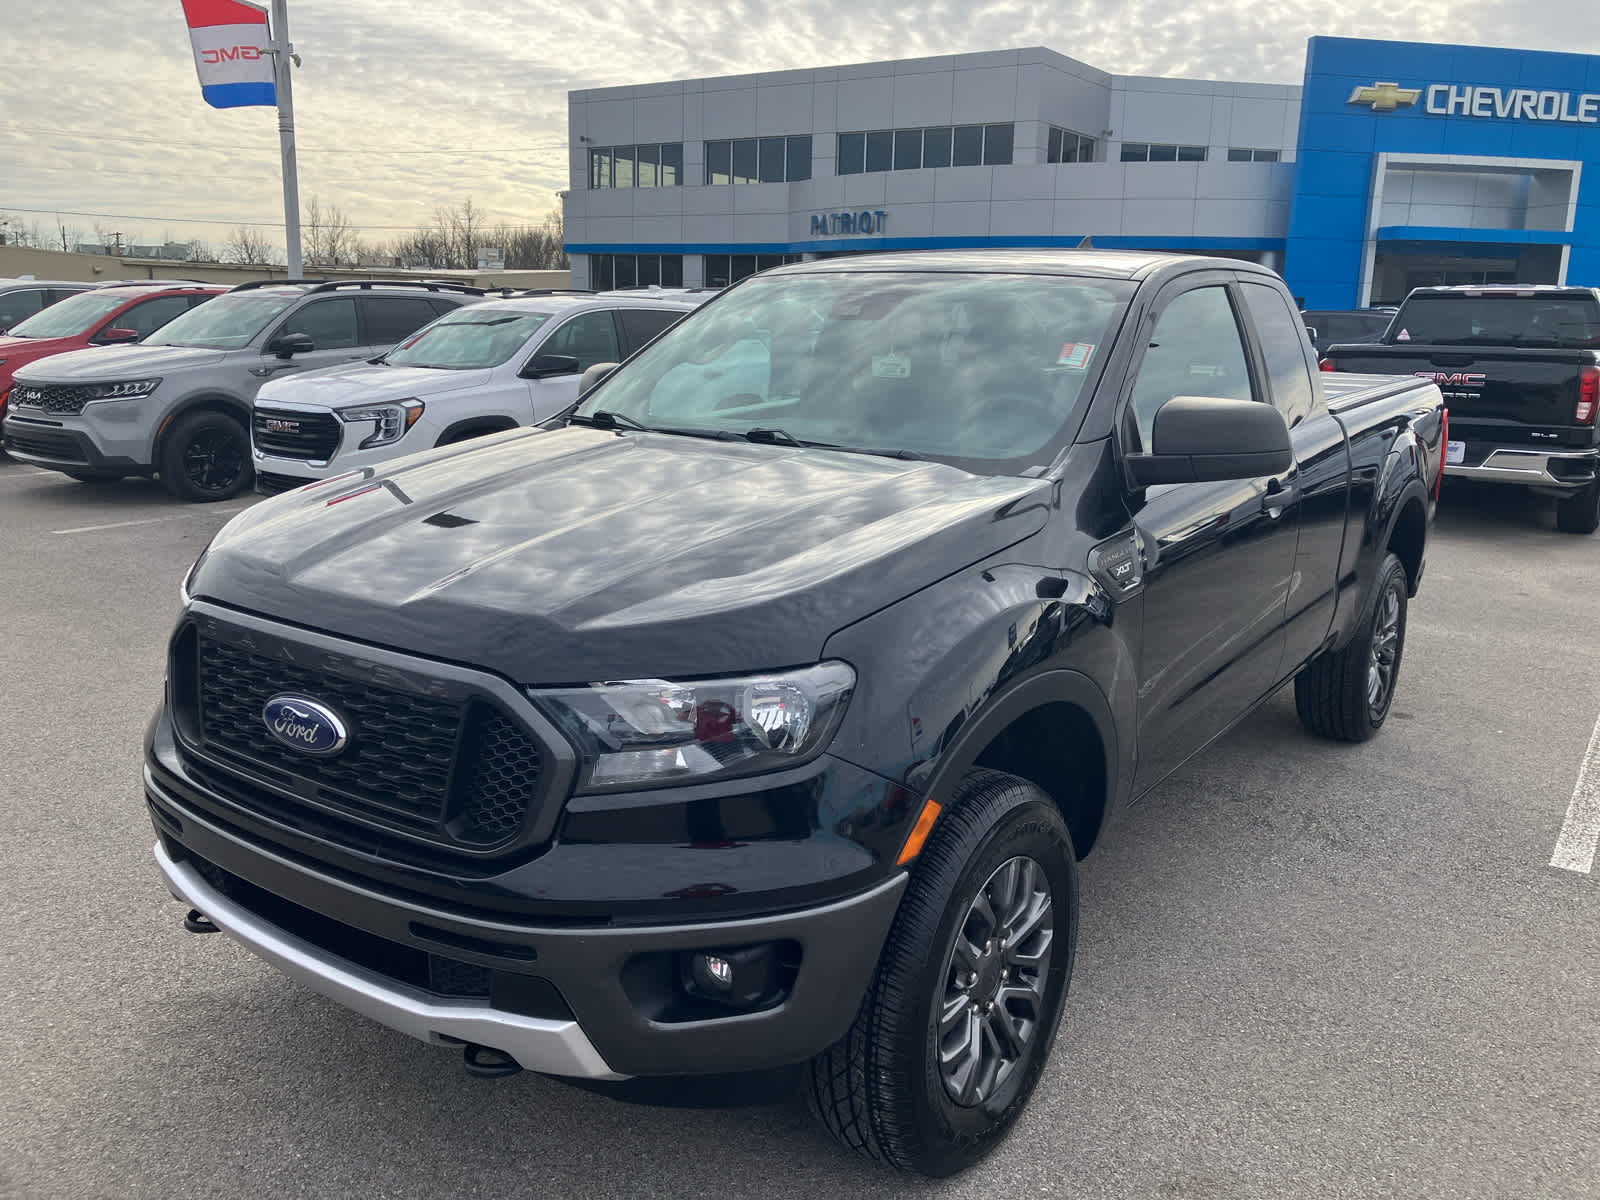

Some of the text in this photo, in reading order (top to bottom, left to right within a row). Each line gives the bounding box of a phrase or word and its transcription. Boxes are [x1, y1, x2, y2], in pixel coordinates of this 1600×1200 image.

[809, 210, 888, 236] PATRIOT
[265, 419, 300, 433] GMC
[1116, 561, 1132, 577] XLT
[274, 705, 319, 744] Ford
